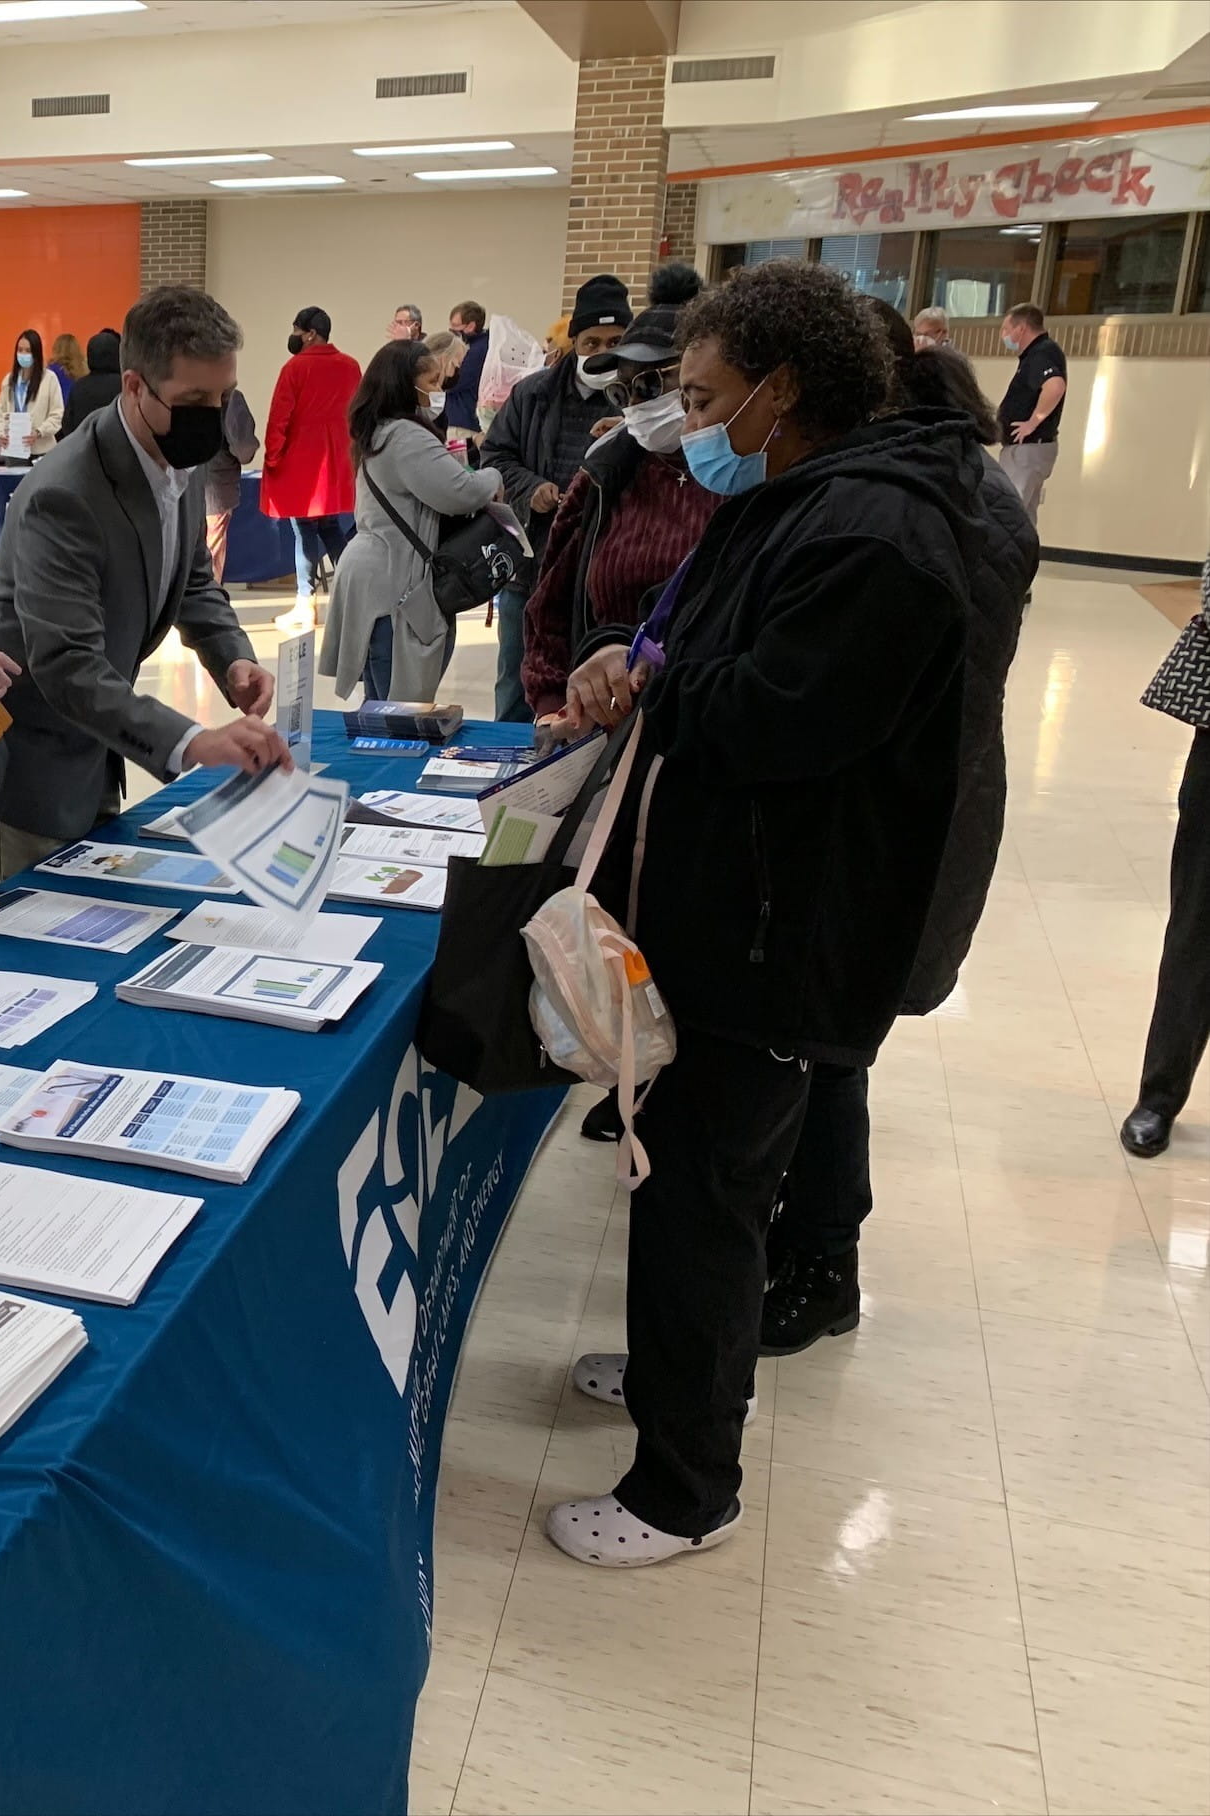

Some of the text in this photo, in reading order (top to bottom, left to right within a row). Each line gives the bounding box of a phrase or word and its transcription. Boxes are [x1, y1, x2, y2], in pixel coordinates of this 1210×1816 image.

[832, 149, 1155, 225] Reality Check
[459, 1162, 472, 1201] OF
[459, 1217, 475, 1273] AND
[471, 1149, 504, 1228] ENERGY
